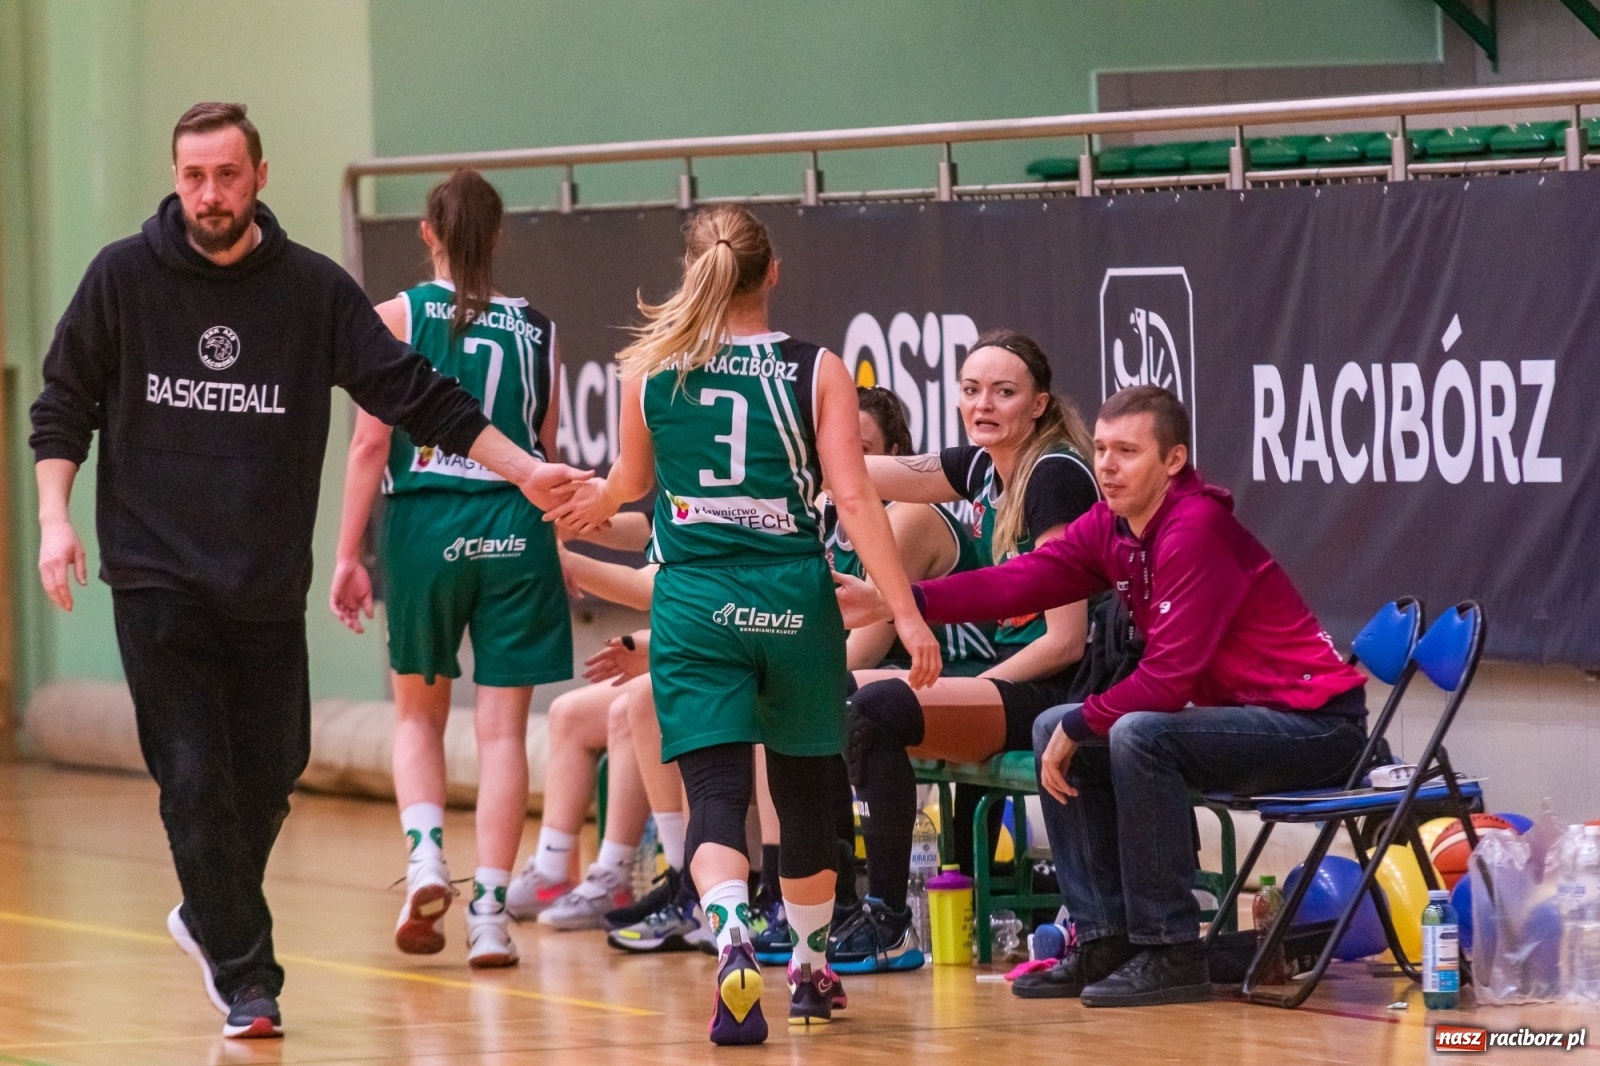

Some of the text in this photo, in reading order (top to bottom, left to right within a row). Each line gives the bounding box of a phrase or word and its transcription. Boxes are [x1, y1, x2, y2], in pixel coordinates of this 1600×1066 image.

[425, 302, 457, 320] RKK
[463, 337, 504, 425] 7
[704, 351, 799, 382] RACIBÓRZ
[146, 372, 286, 415] BASKETBALL
[1252, 313, 1563, 486] RACIBÓRZ
[698, 387, 749, 487] 3
[464, 533, 527, 556] Clavis
[734, 606, 804, 629] Clavis
